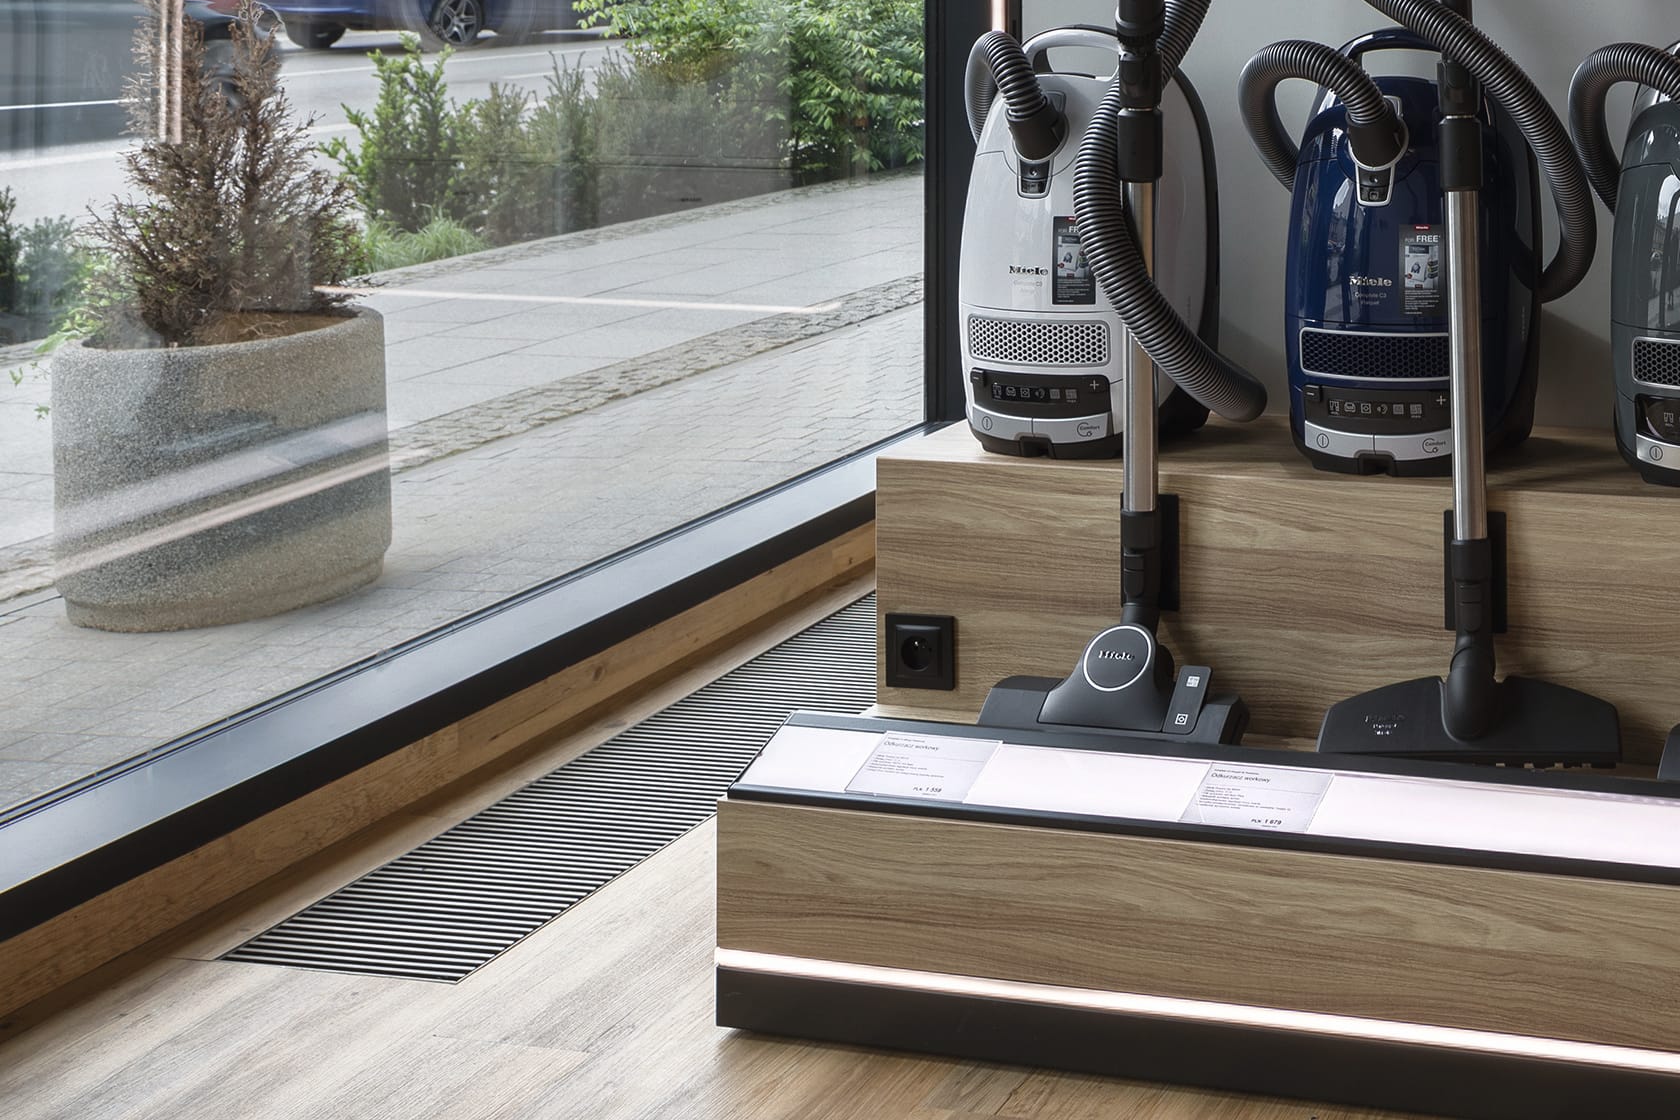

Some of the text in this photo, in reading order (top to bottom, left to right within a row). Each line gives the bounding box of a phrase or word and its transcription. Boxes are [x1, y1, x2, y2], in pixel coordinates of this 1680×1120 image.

[1009, 265, 1048, 276] Miele
[1349, 275, 1392, 286] Miele
[1211, 772, 1243, 780] Odkurzacz
